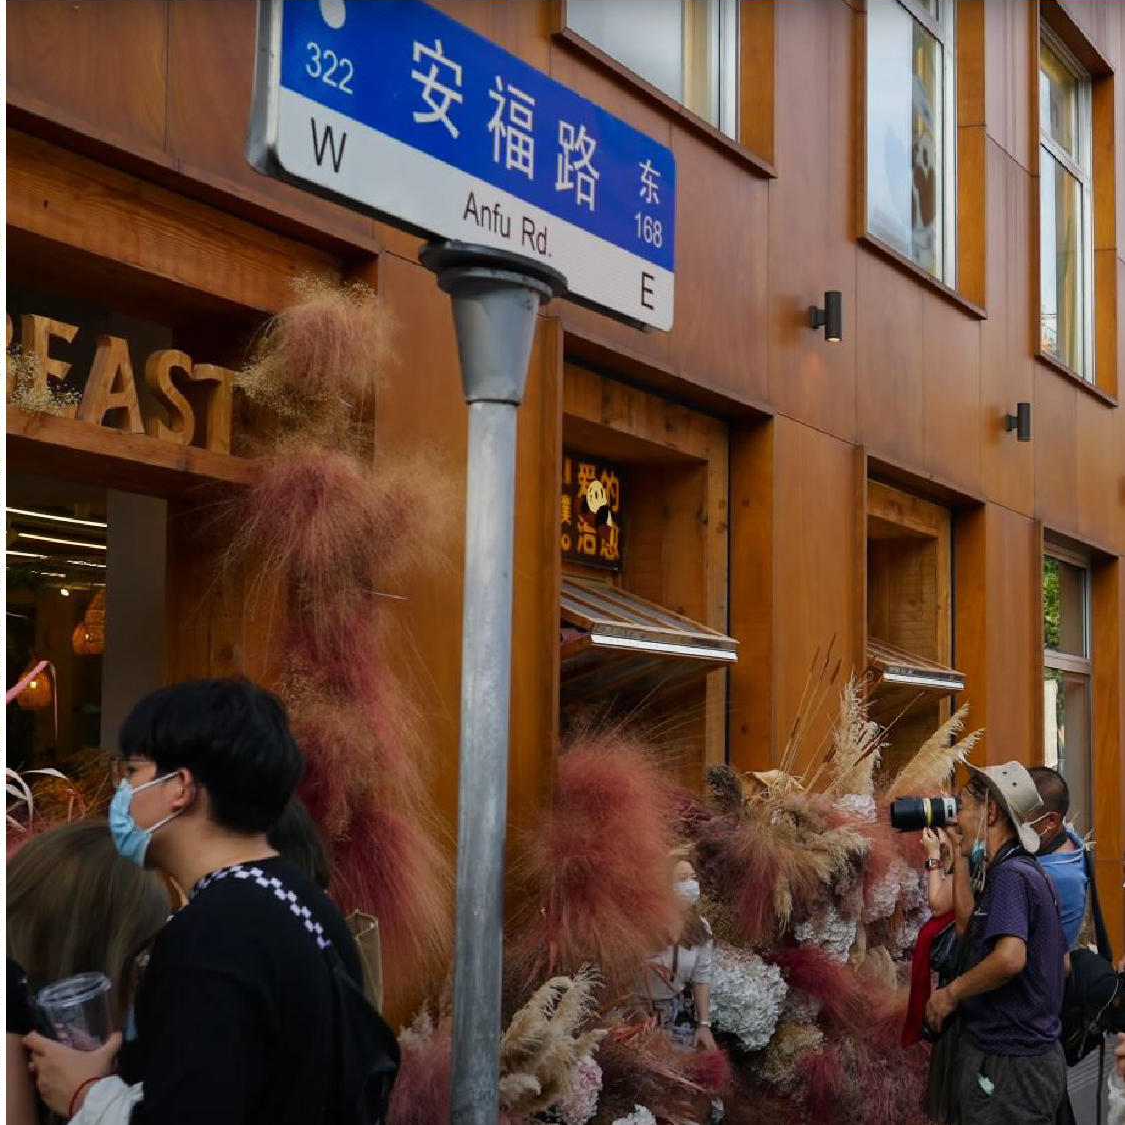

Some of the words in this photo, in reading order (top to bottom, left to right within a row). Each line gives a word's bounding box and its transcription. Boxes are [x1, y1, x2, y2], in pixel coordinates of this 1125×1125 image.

[306, 42, 354, 95] 322
[311, 117, 347, 173] W
[411, 38, 600, 212] 安福路
[639, 159, 662, 206] 东
[463, 191, 511, 241] Anfu
[522, 216, 553, 258] Rd.
[634, 211, 663, 250] 168
[641, 271, 656, 311] E
[6, 311, 242, 456] EAST
